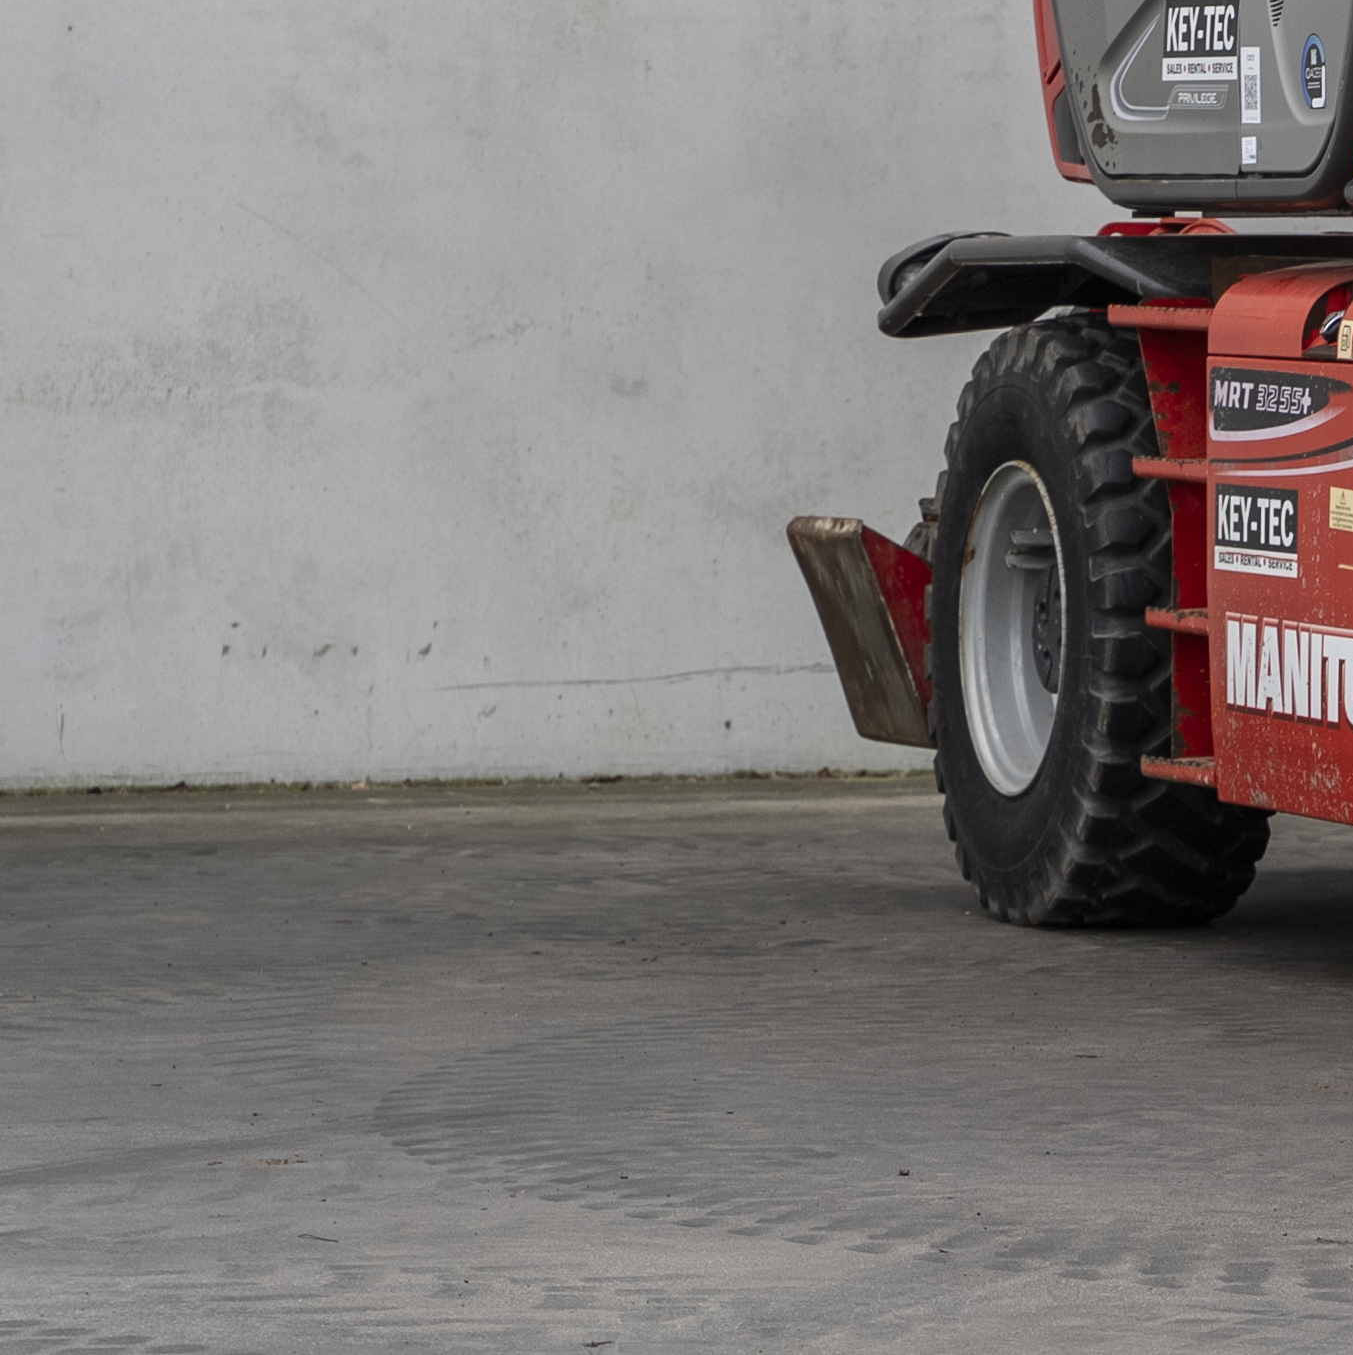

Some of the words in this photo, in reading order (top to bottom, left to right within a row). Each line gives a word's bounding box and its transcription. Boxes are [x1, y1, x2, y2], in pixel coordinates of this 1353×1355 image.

[1166, 4, 1235, 52] KEY-TEC
[1166, 63, 1183, 75] SALES
[1187, 62, 1207, 74] RENTAL
[1212, 61, 1234, 74] SERVICE
[1177, 92, 1218, 105] PRIVILEGE
[1214, 380, 1254, 410] MRT
[1217, 494, 1295, 547] KEY-TEC
[1218, 552, 1234, 565] SALES
[1240, 555, 1262, 569] RENTAL
[1268, 559, 1293, 571] SERVICE
